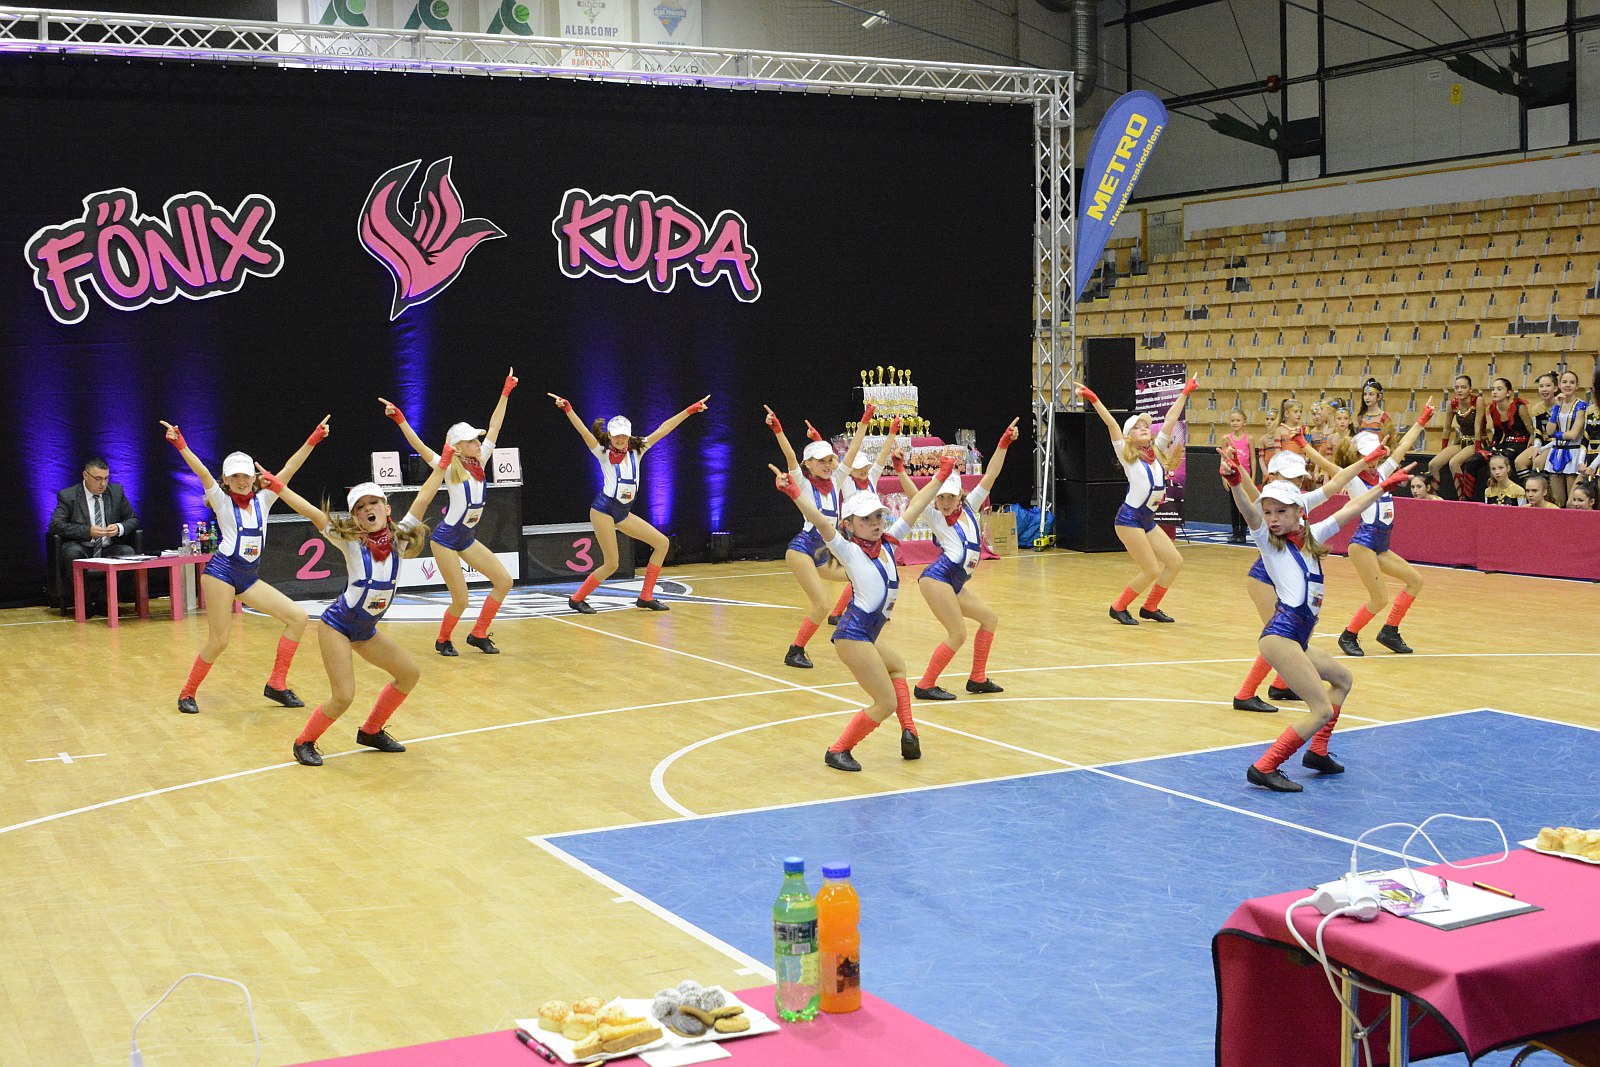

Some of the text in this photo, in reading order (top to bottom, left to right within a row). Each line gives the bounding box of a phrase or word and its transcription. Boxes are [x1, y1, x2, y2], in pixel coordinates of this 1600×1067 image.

[564, 24, 619, 37] ALBACOMP
[1086, 113, 1148, 221] METRO
[33, 195, 758, 315] FŐNIX KUPA
[379, 467, 398, 478] 62.
[498, 461, 515, 474] 60.
[295, 537, 332, 580] 2
[565, 537, 594, 573] 3
